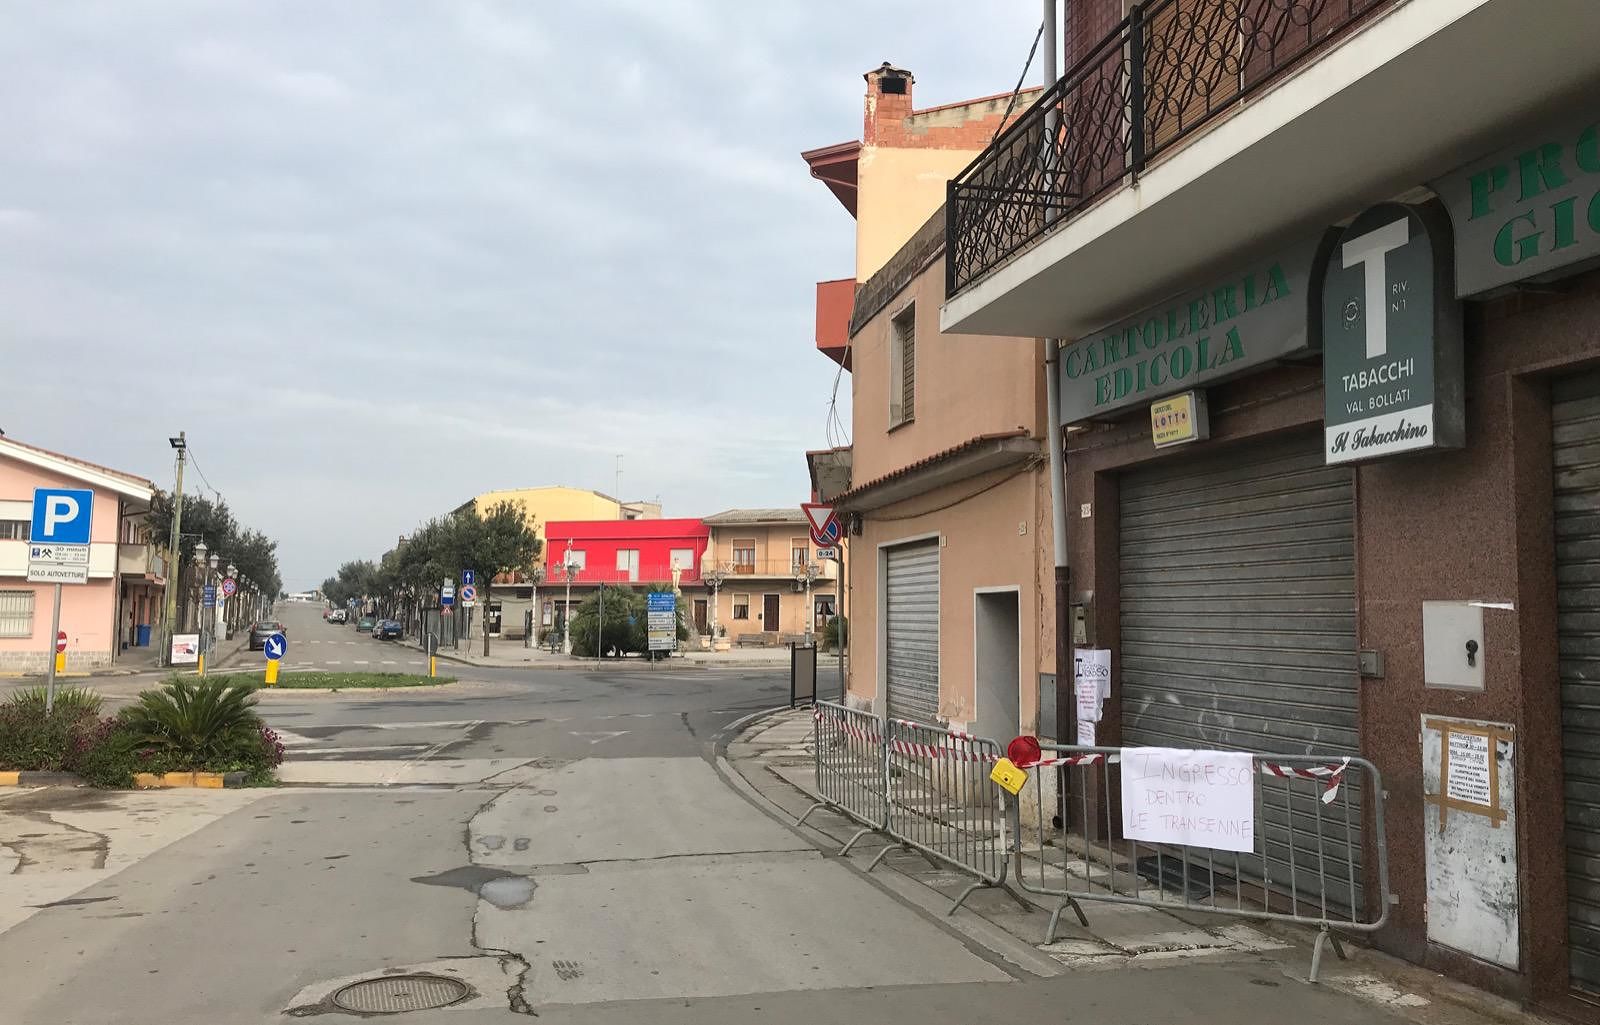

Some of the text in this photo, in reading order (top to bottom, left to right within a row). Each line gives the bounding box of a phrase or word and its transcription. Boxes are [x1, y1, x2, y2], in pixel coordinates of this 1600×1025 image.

[1494, 190, 1600, 266] GI
[1342, 216, 1409, 359] T
[1065, 262, 1291, 380] CARTOLERIA
[1094, 325, 1246, 407] EDICOLA
[1342, 357, 1414, 393] TABACCHI
[1369, 388, 1410, 409] BOLLATI
[1154, 411, 1186, 429] LOTTO
[1351, 418, 1428, 451] Tabacchino
[44, 495, 79, 537] P
[47, 570, 85, 578] AUTOVETTURE
[1132, 753, 1253, 785] INGRESSO
[1145, 789, 1206, 806] DENTRO
[1130, 809, 1252, 840] LE TRANSENNE
